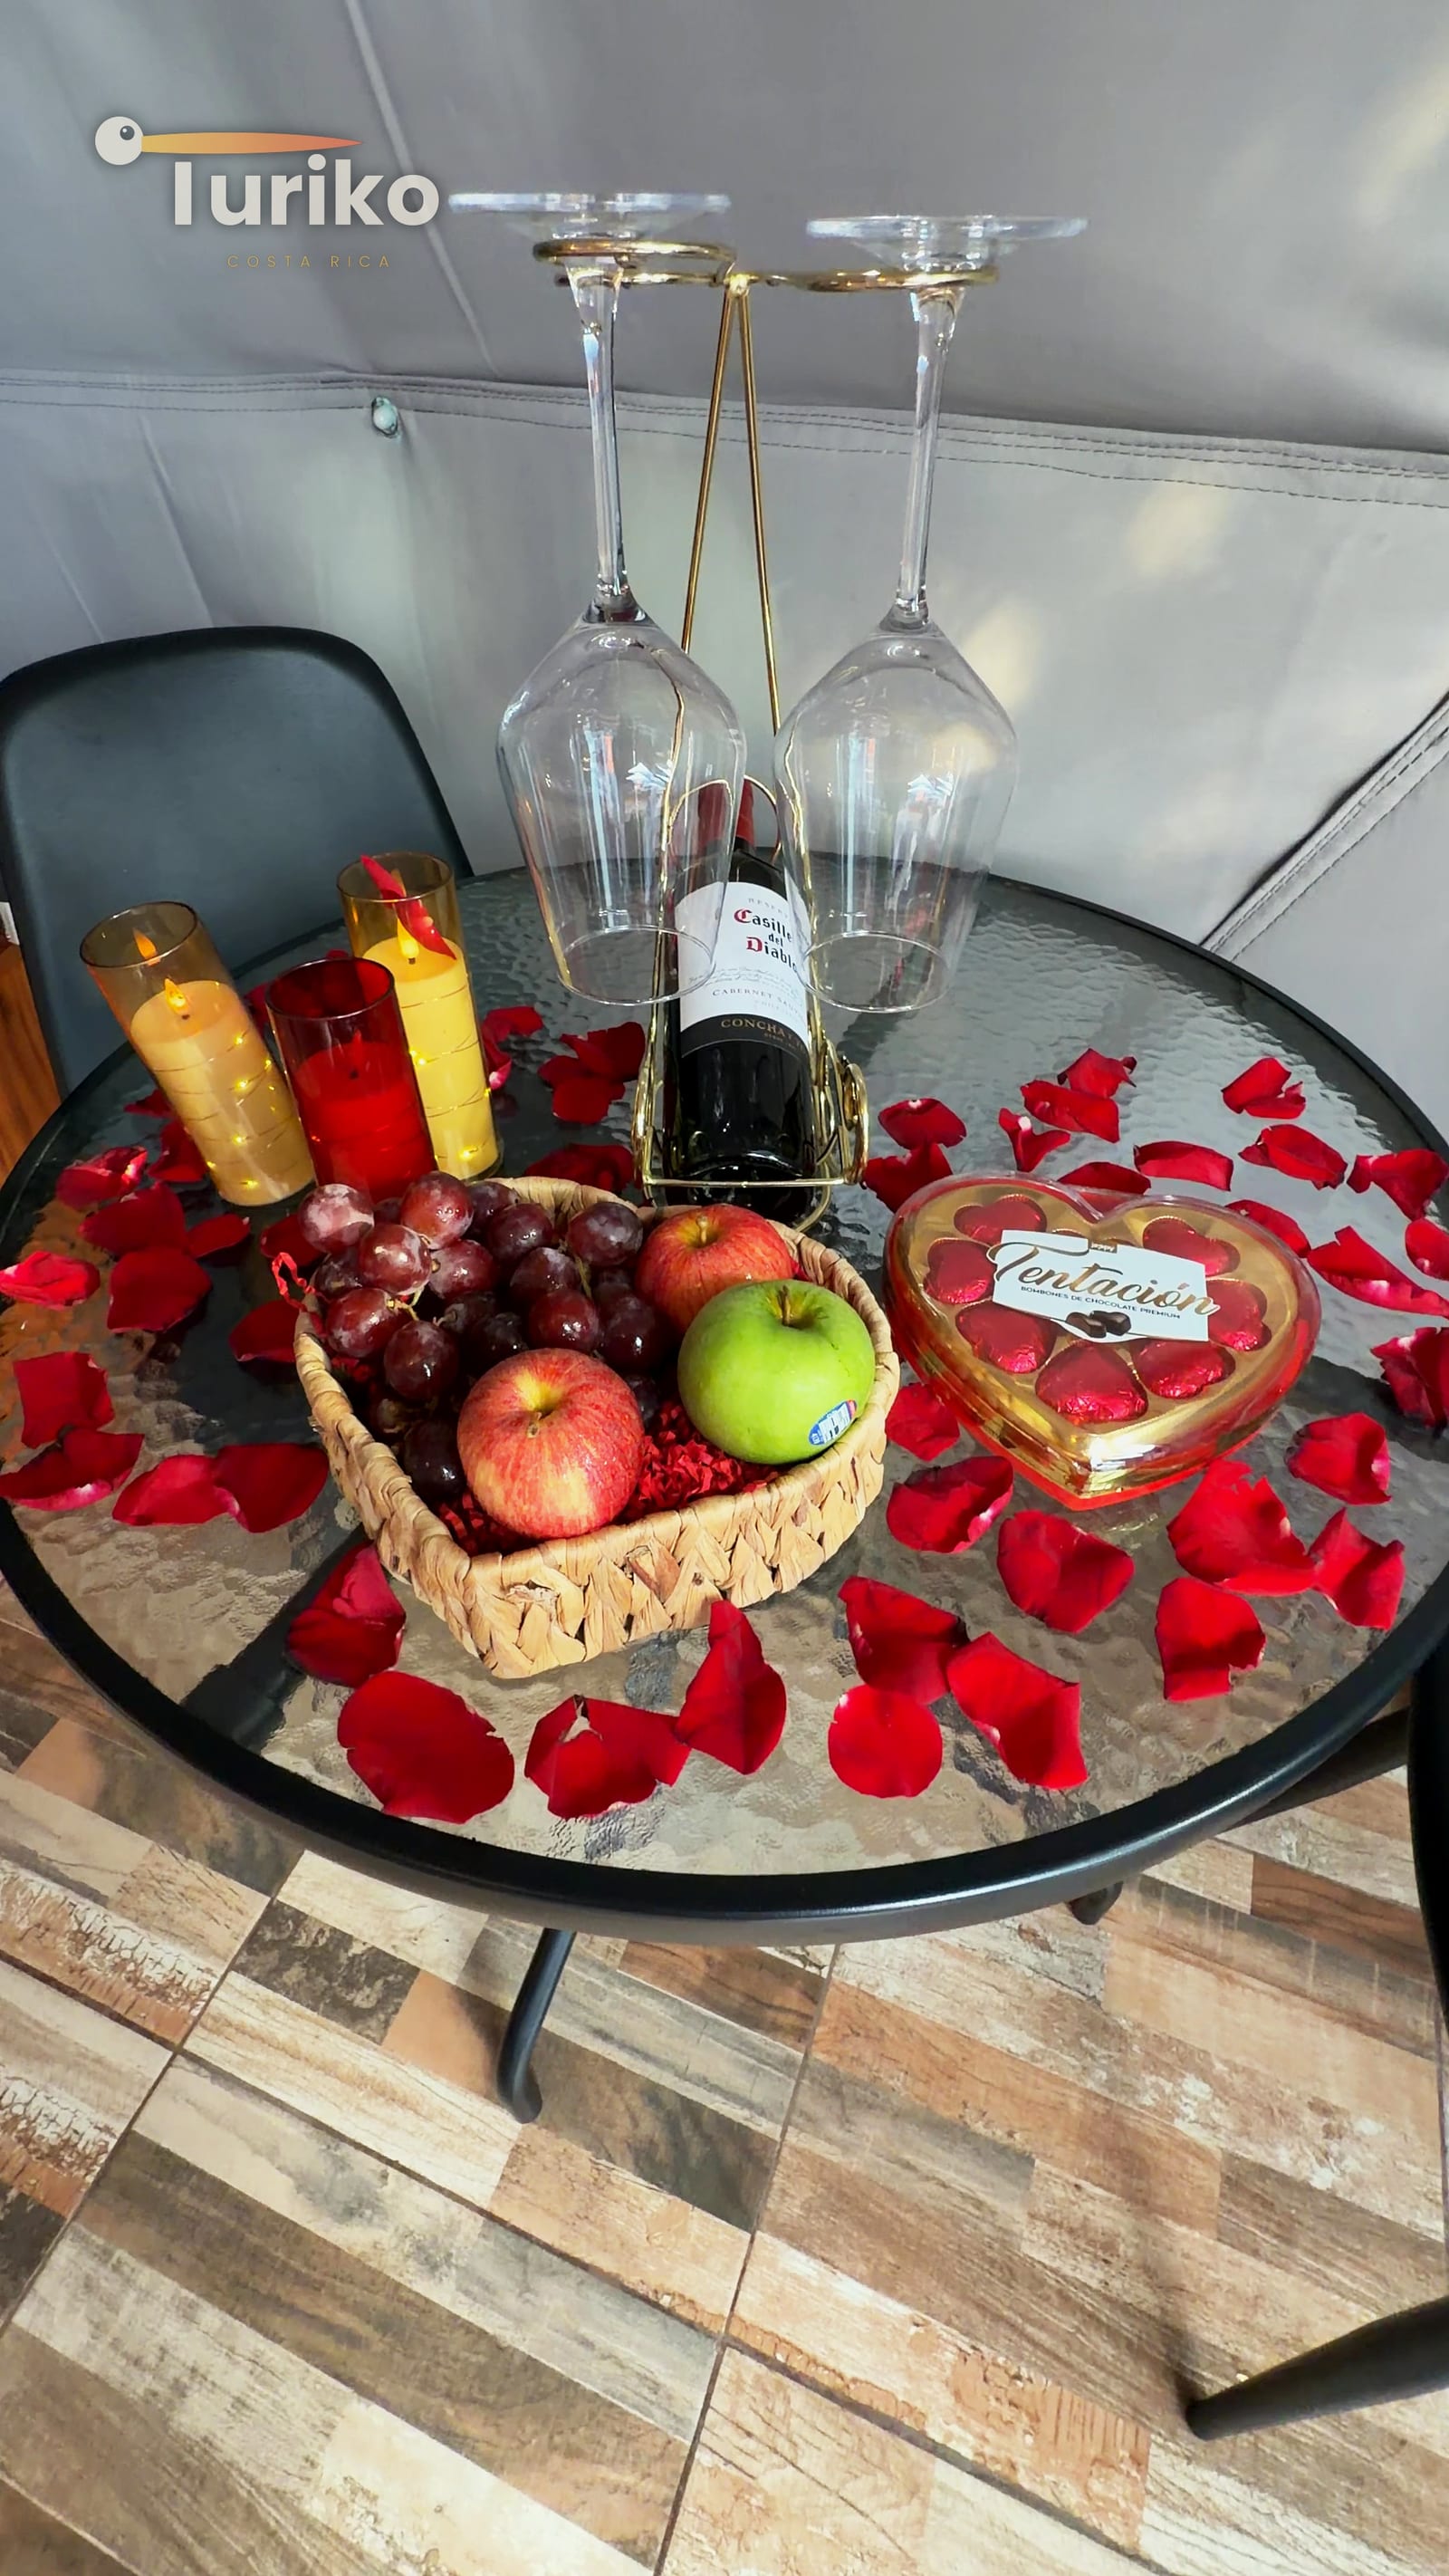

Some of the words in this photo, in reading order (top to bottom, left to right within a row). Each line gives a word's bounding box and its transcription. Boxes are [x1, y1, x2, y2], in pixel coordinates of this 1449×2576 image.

[768, 933, 783, 947] del
[713, 988, 772, 999] CABERNET
[721, 1018, 785, 1037] CONCHA
[987, 1241, 1219, 1314] Tentación
[1021, 1286, 1069, 1299] BOMBONES
[1085, 1297, 1137, 1312] CHOCOLATE
[1139, 1308, 1181, 1319] PREMIUM
